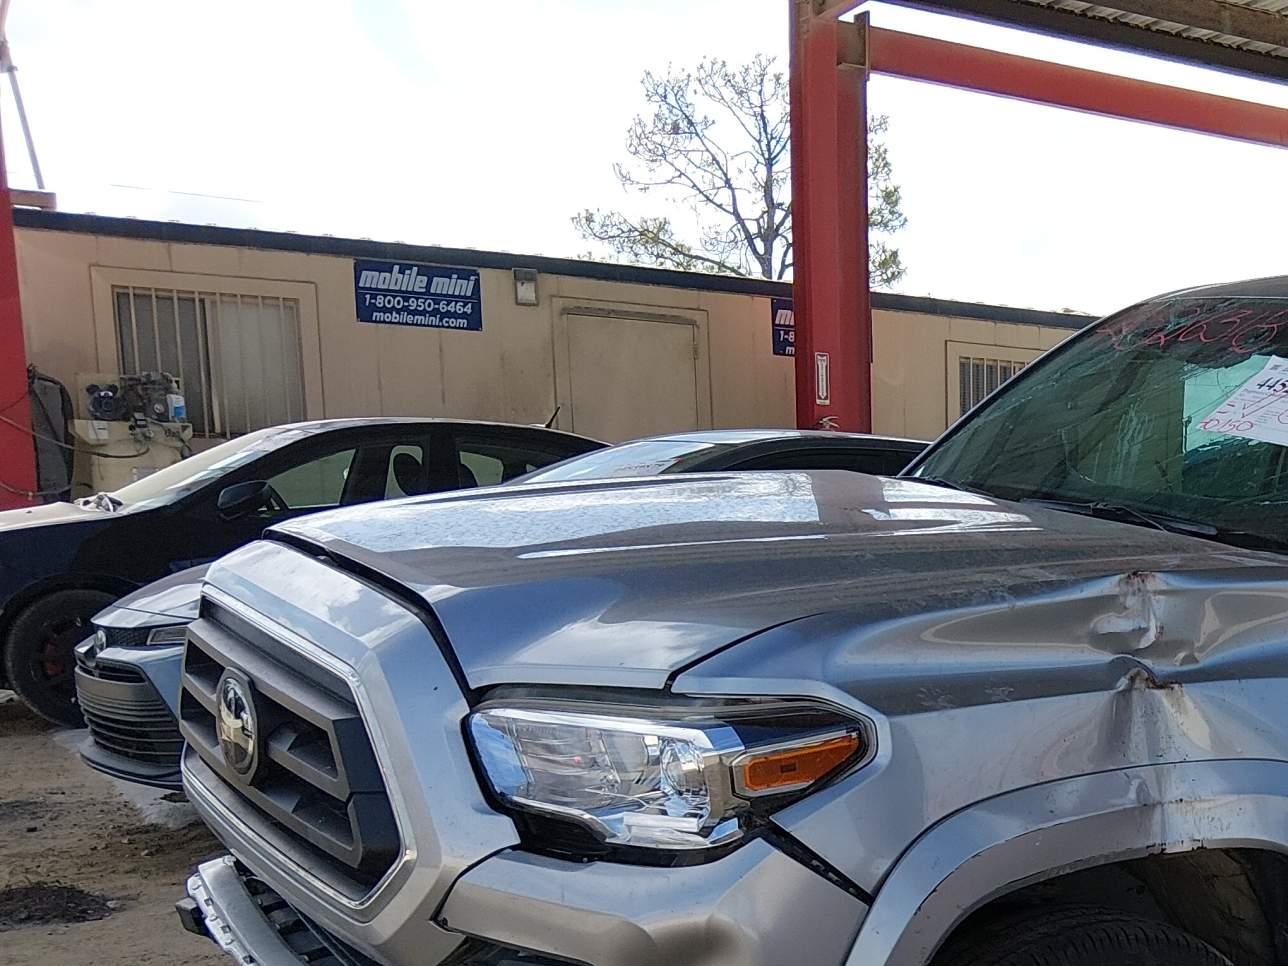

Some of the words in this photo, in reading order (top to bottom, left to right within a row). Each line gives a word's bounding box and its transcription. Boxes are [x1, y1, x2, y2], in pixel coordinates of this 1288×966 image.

[359, 265, 428, 292] mobile
[430, 275, 478, 297] mini
[364, 294, 473, 315] 1-800-950-6464
[372, 311, 468, 328] mobilemini.com
